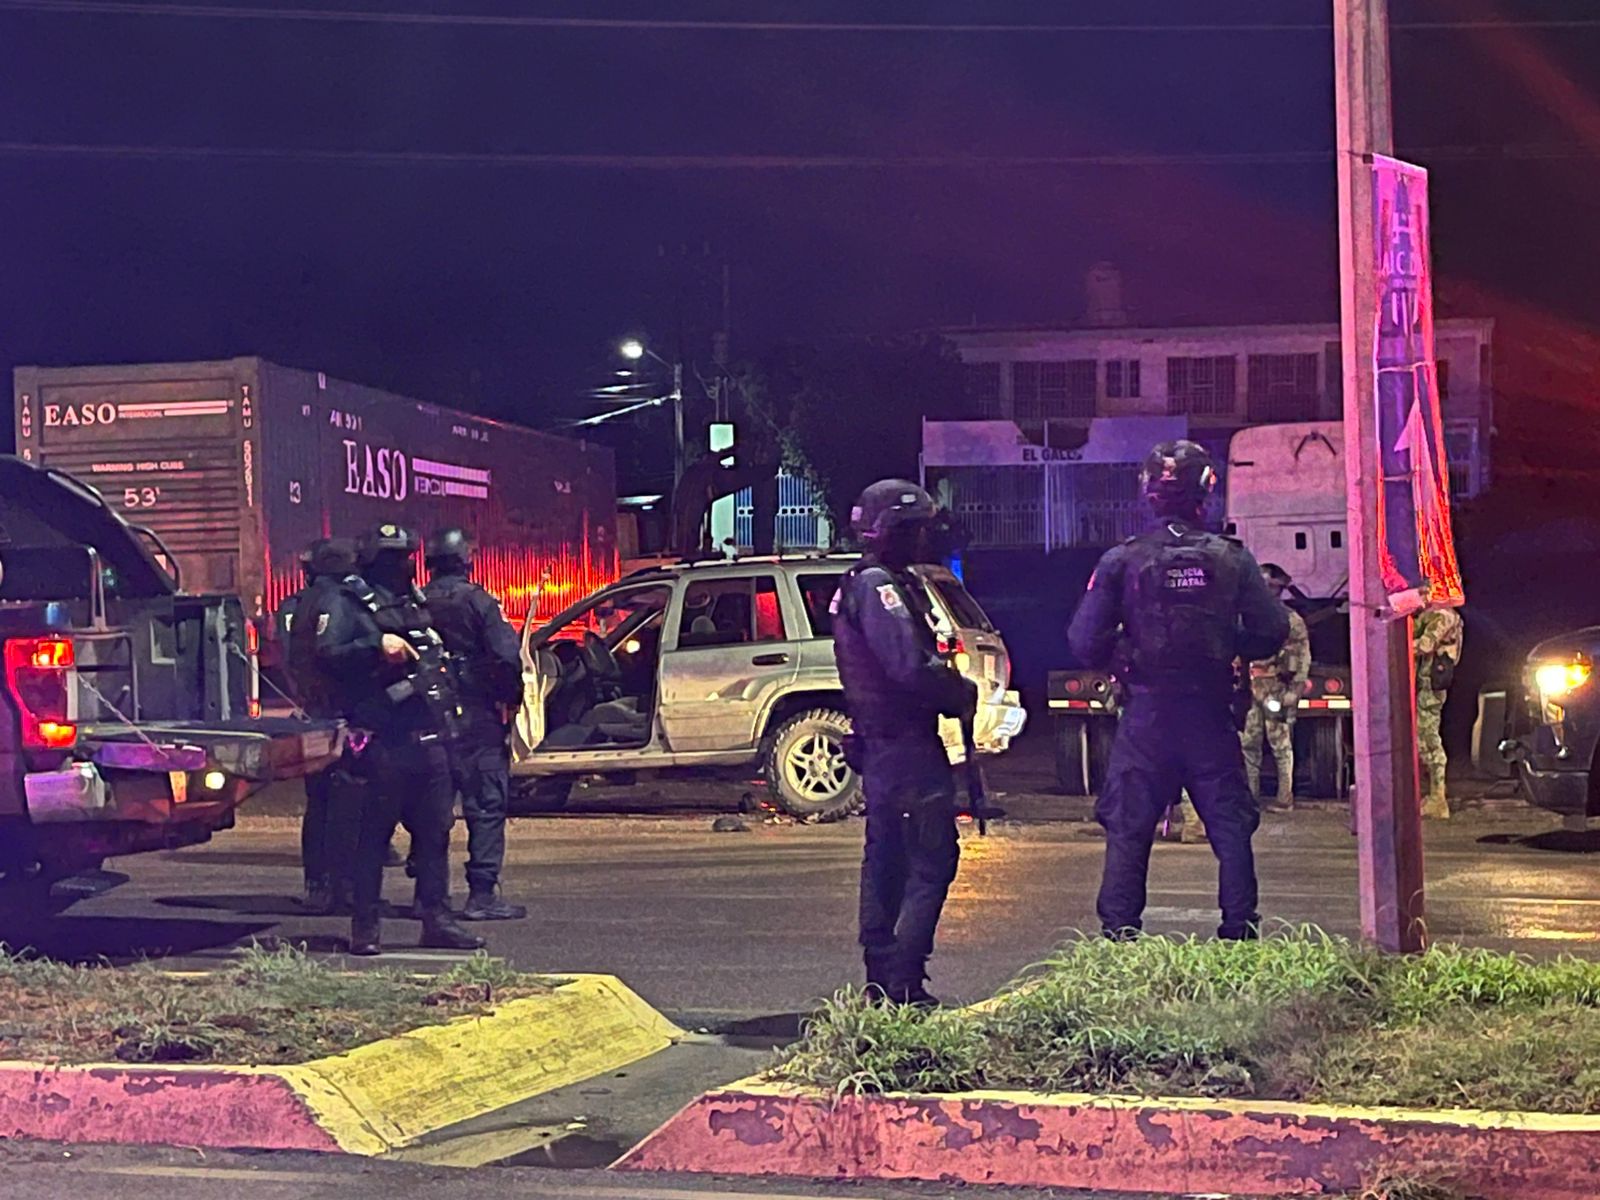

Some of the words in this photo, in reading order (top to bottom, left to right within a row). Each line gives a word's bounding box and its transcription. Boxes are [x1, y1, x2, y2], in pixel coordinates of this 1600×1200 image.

[22, 395, 32, 437] TAMU
[44, 402, 116, 426] EASO
[242, 385, 252, 428] TAMU
[343, 438, 407, 501] EASO
[1022, 447, 1038, 462] EL
